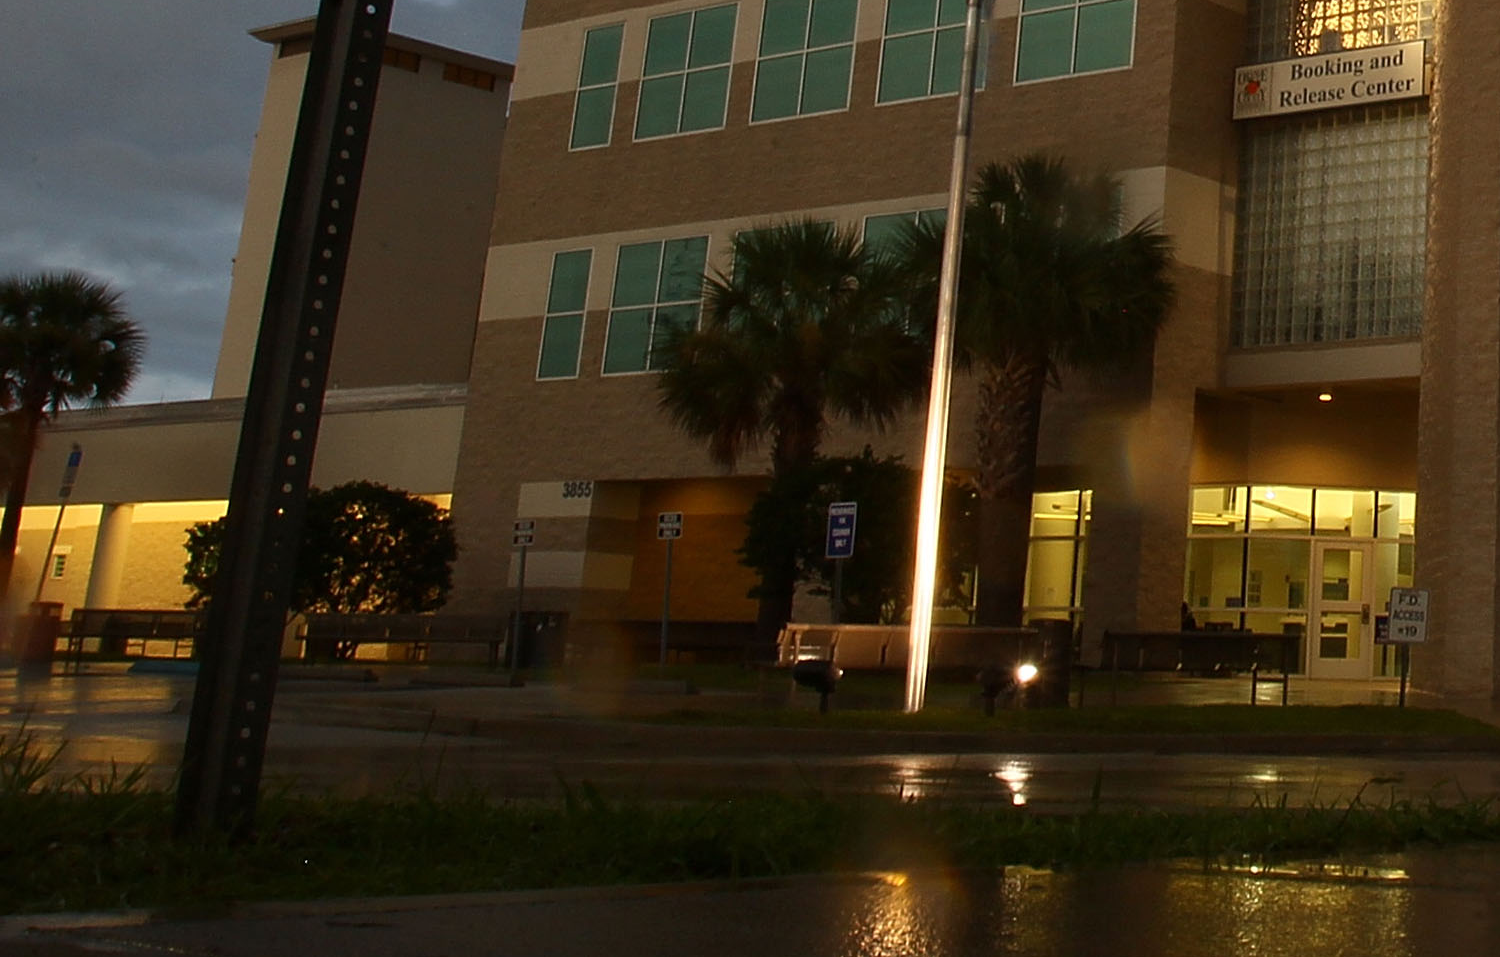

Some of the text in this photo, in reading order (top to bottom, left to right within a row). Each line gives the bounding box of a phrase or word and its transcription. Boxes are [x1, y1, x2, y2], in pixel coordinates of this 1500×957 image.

[1291, 58, 1365, 82] Booking
[1370, 49, 1404, 70] and
[1280, 86, 1345, 108] Release
[1351, 77, 1415, 99] Center
[562, 481, 592, 499] 3855
[1393, 609, 1425, 623] ACCESS
